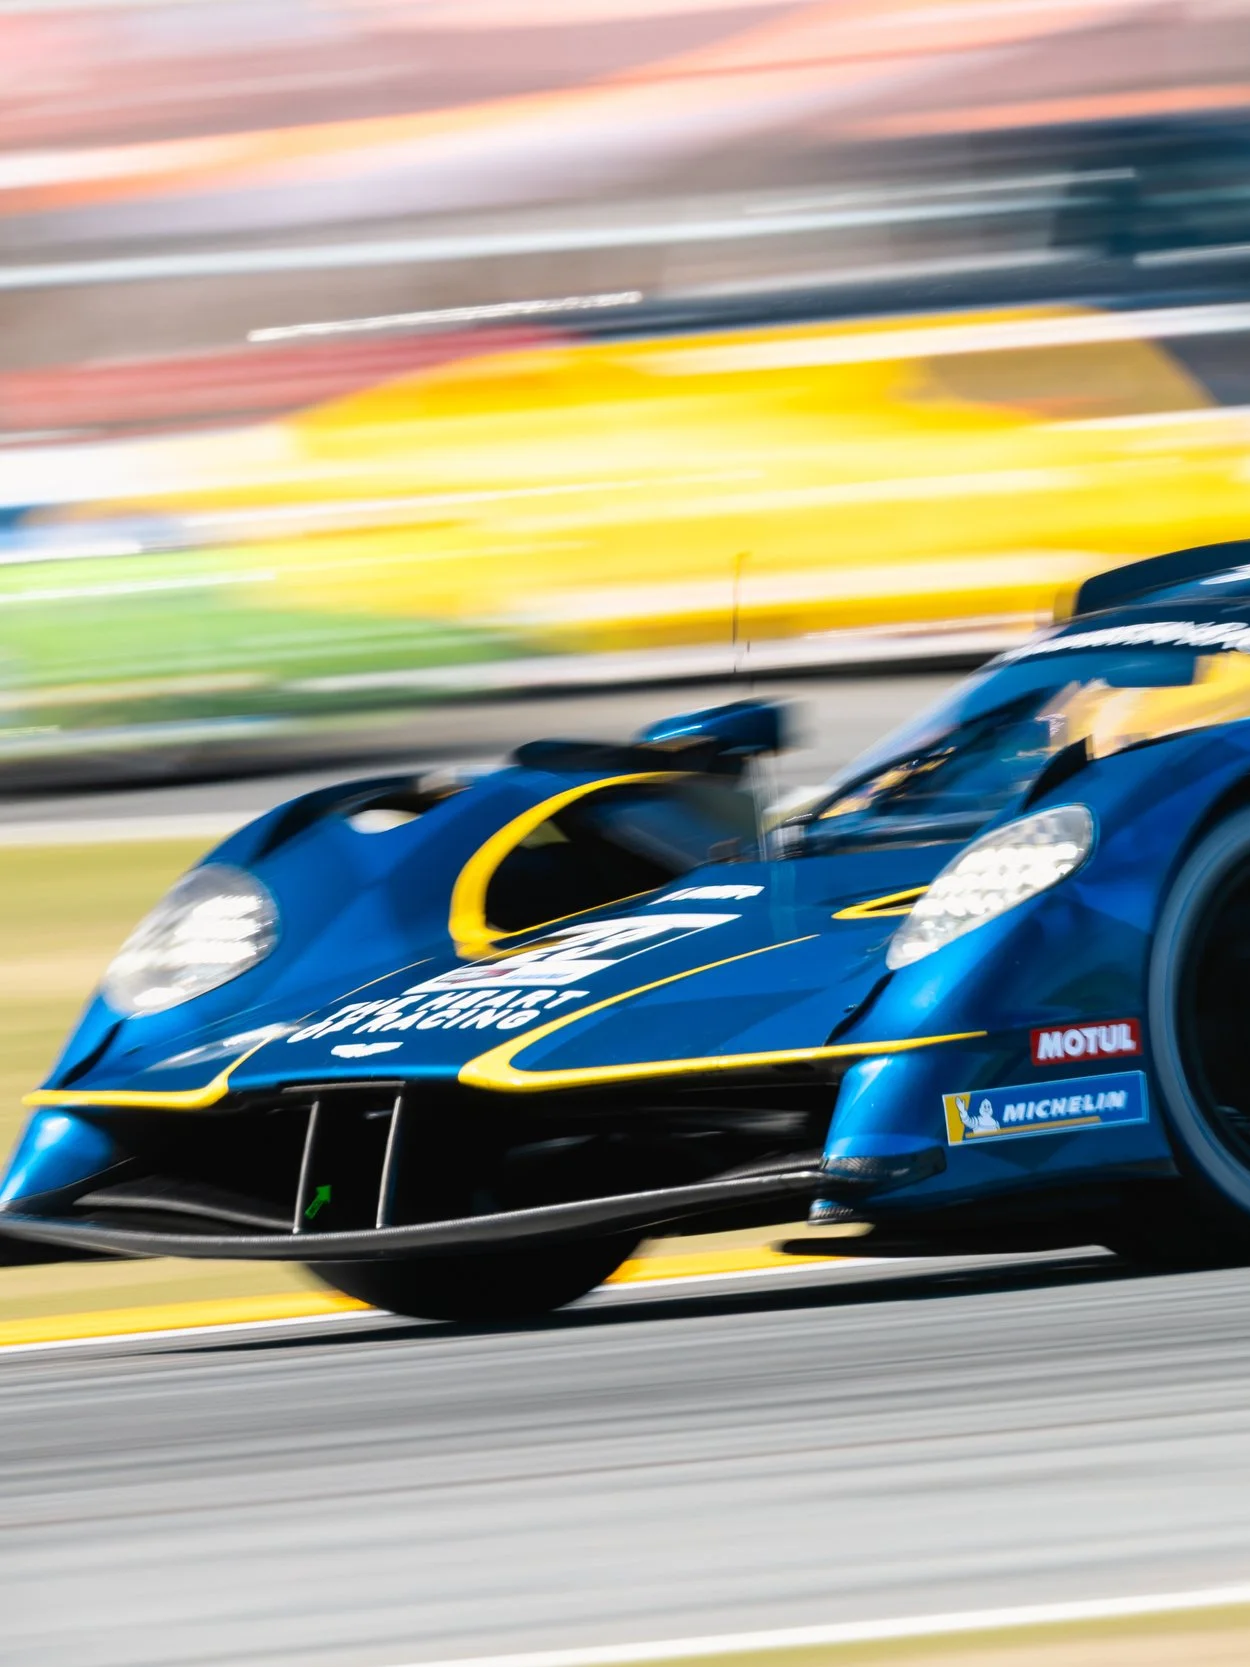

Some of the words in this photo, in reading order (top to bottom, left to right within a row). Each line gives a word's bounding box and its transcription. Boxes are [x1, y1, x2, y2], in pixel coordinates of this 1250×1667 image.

[323, 994, 428, 1022] THE
[415, 989, 590, 1012] HEART
[352, 1008, 541, 1035] RACING
[1036, 1023, 1137, 1060] MOTUL
[1002, 1090, 1129, 1122] MICHELIN
